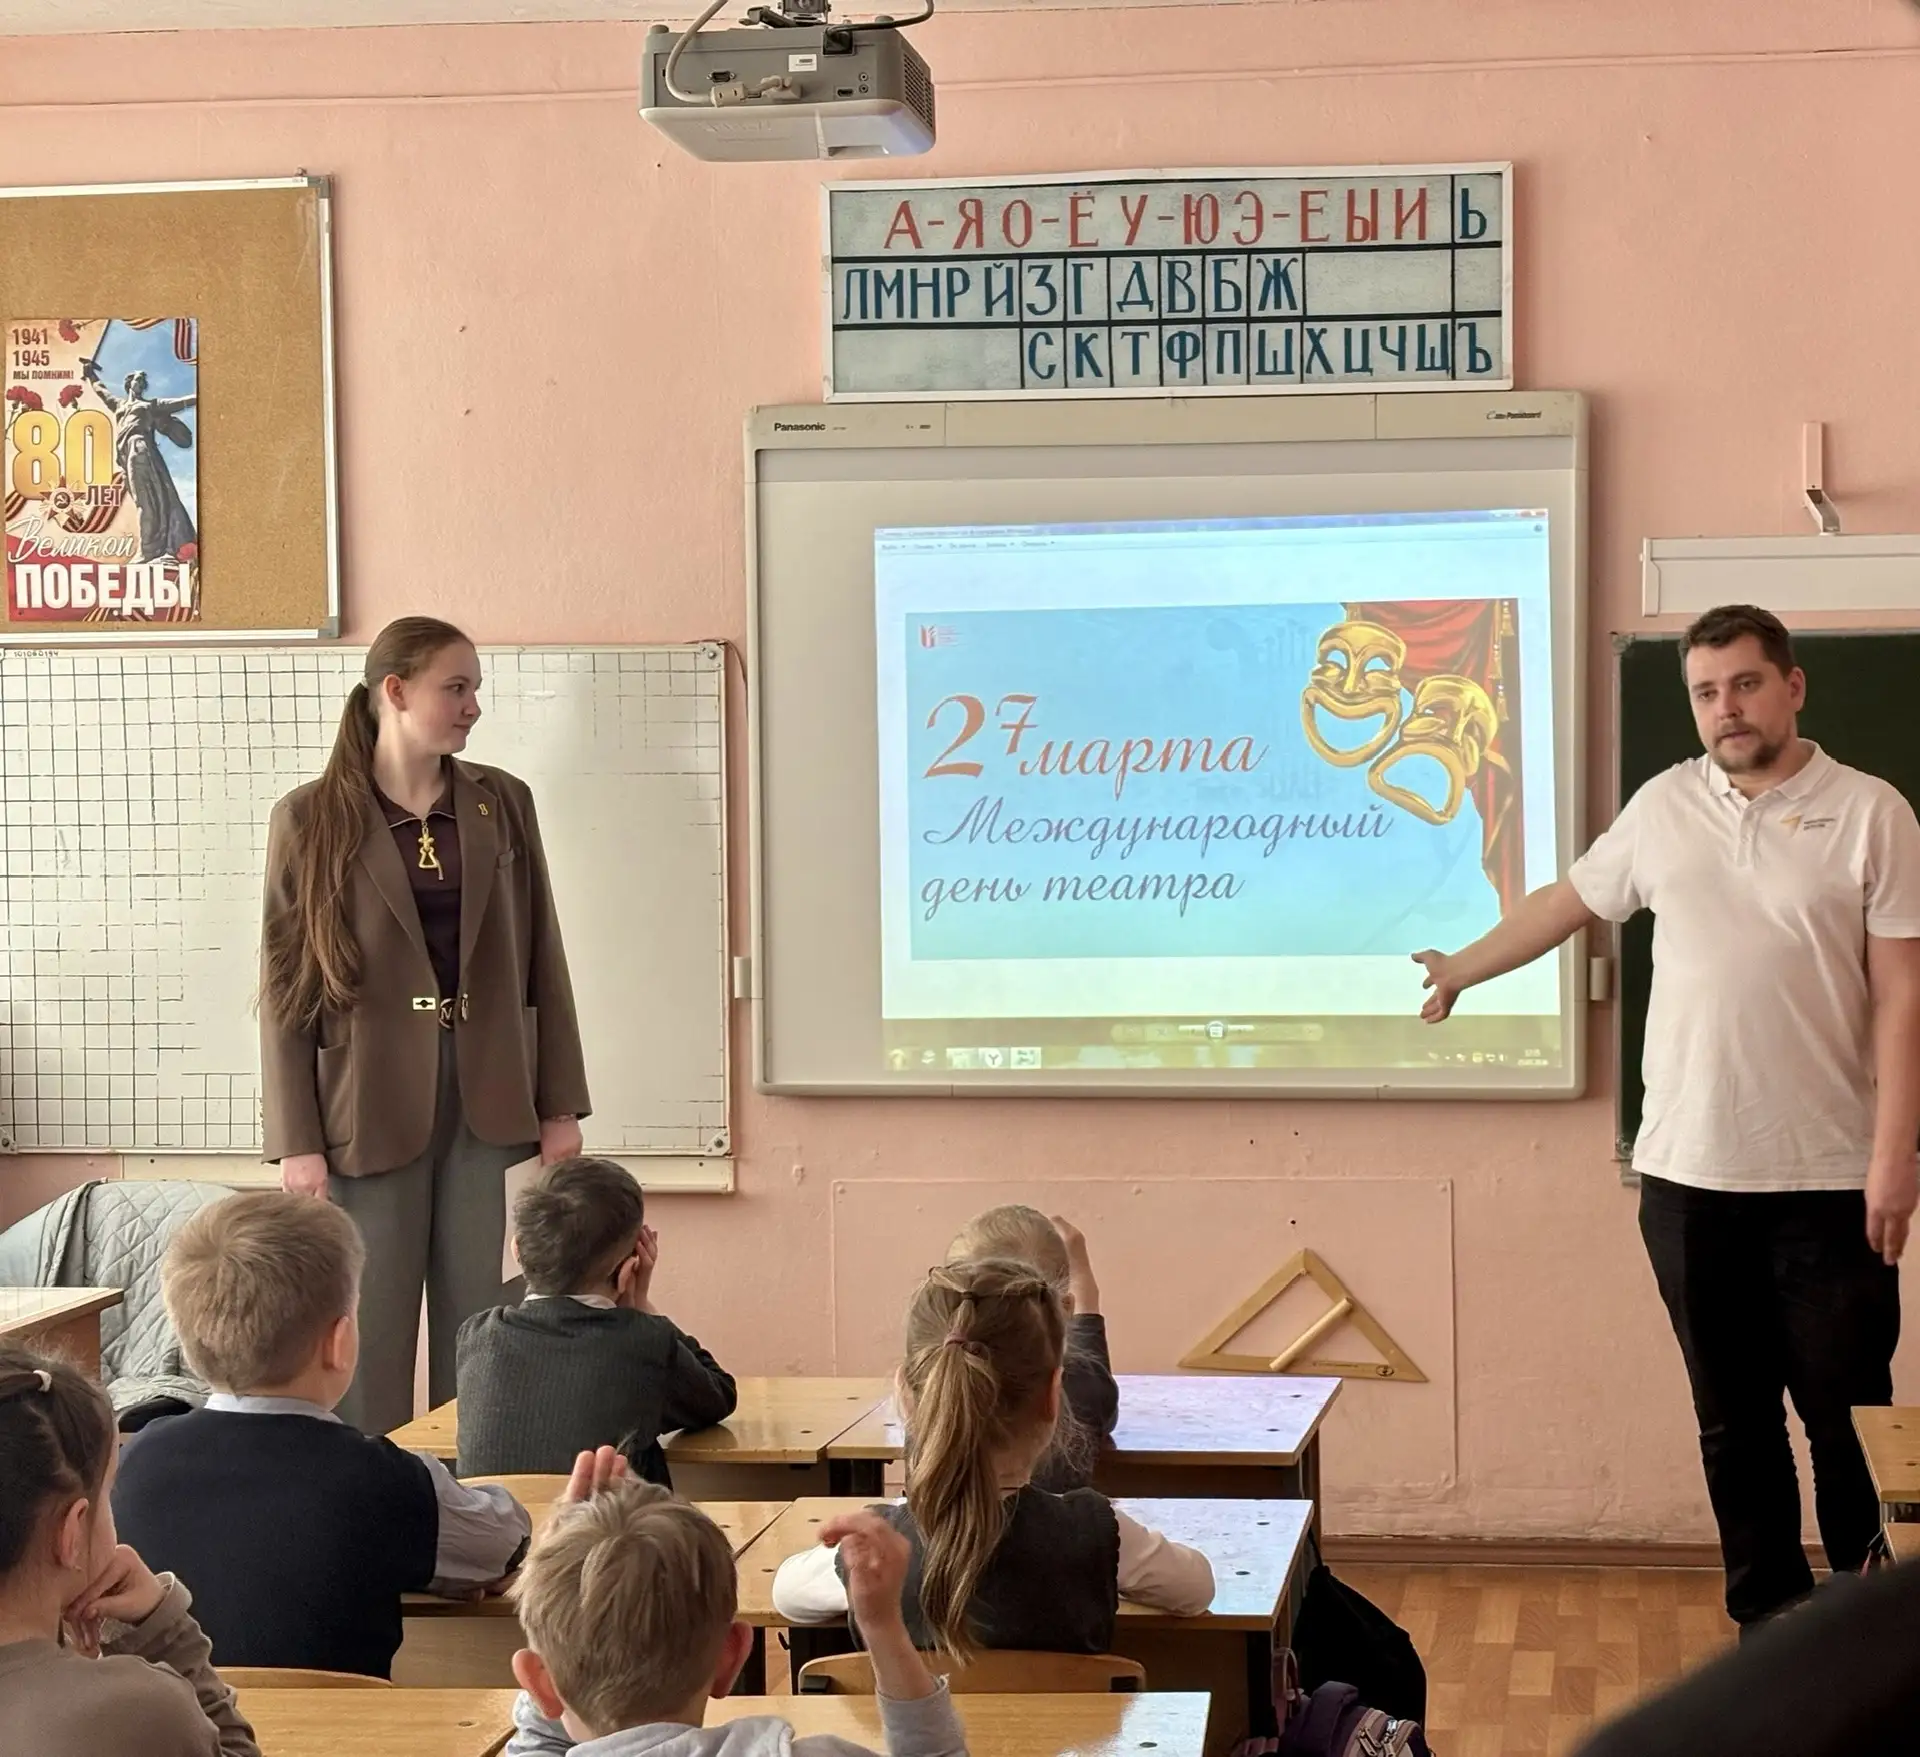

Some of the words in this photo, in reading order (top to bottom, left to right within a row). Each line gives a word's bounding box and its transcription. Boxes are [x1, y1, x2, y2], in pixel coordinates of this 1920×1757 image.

[1459, 187, 1488, 240] Ь
[1071, 262, 1094, 316] Г
[1115, 260, 1154, 314] Д
[1165, 259, 1197, 314] В
[1212, 257, 1243, 313] Б
[1255, 256, 1299, 311] Ж
[12, 328, 48, 346] 1941
[13, 349, 50, 367] 1945
[1028, 331, 1057, 380] С
[1075, 332, 1104, 379] К
[1119, 331, 1150, 376] Т
[1165, 330, 1201, 379] Ф
[1216, 329, 1243, 375] П
[1255, 328, 1296, 376] Ш
[1457, 322, 1493, 374] Ъ
[13, 370, 30, 380] МЫ
[31, 370, 75, 380] ПОМНИМ!
[773, 421, 827, 432] Panasonic
[12, 409, 115, 500] 80
[85, 484, 124, 508] ЛЕТ
[6, 516, 135, 563] Великой
[15, 562, 192, 616] ПОБЕДЫ
[923, 693, 1040, 779] 27
[1019, 735, 1270, 801] марта
[922, 796, 1395, 860] Международный
[921, 877, 1032, 922] день
[1042, 872, 1246, 918] театра
